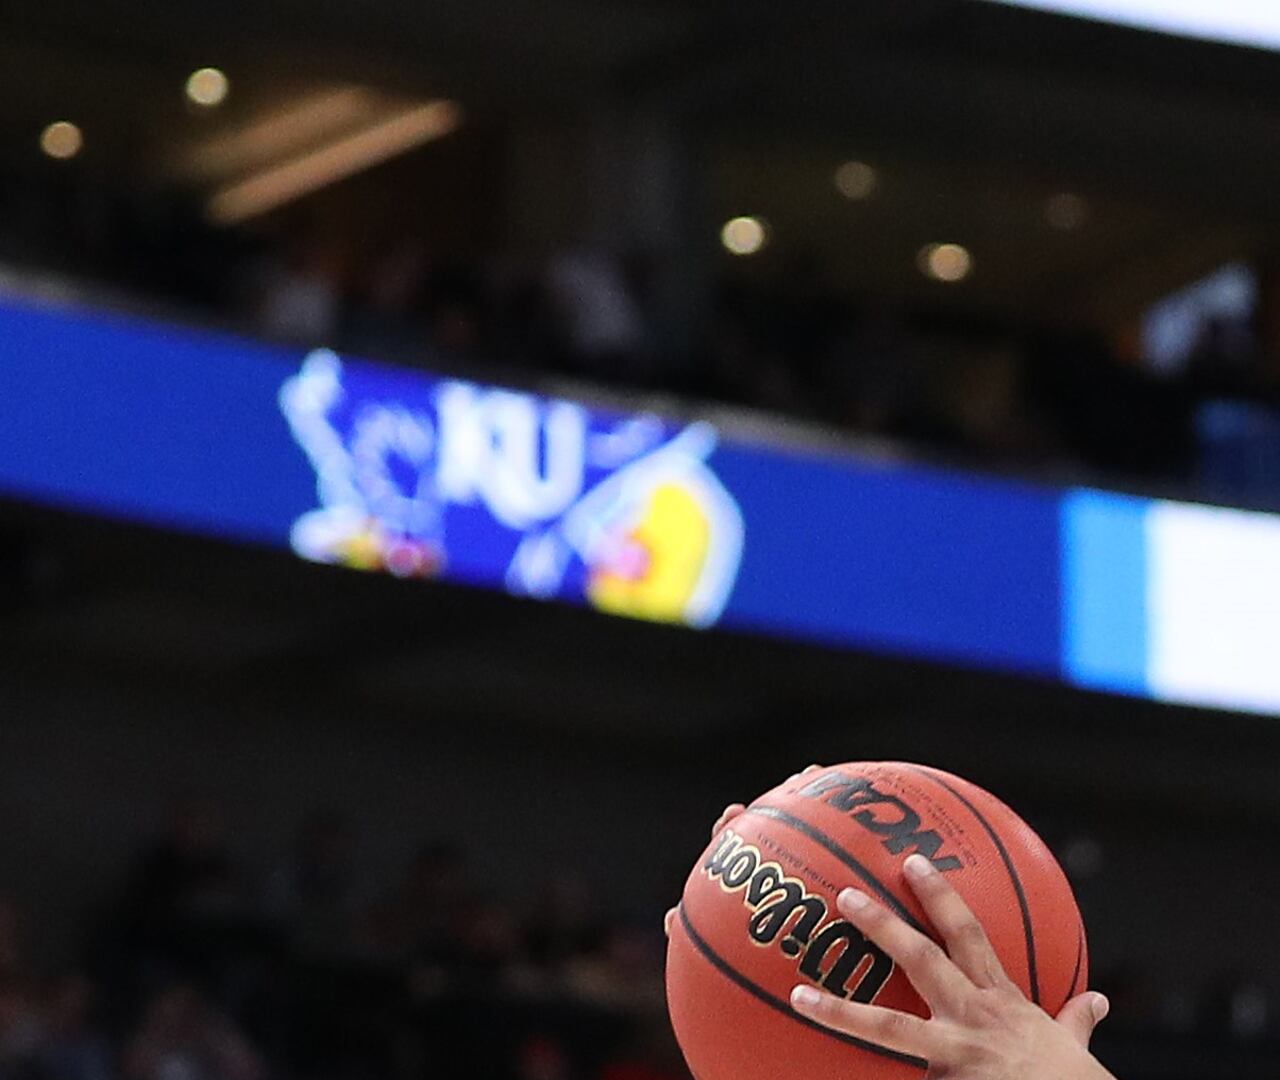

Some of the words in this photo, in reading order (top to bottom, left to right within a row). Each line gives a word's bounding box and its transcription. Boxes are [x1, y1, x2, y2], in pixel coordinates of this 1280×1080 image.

[438, 381, 586, 529] KU
[797, 771, 964, 873] NCAA
[703, 829, 896, 1005] Wilson
